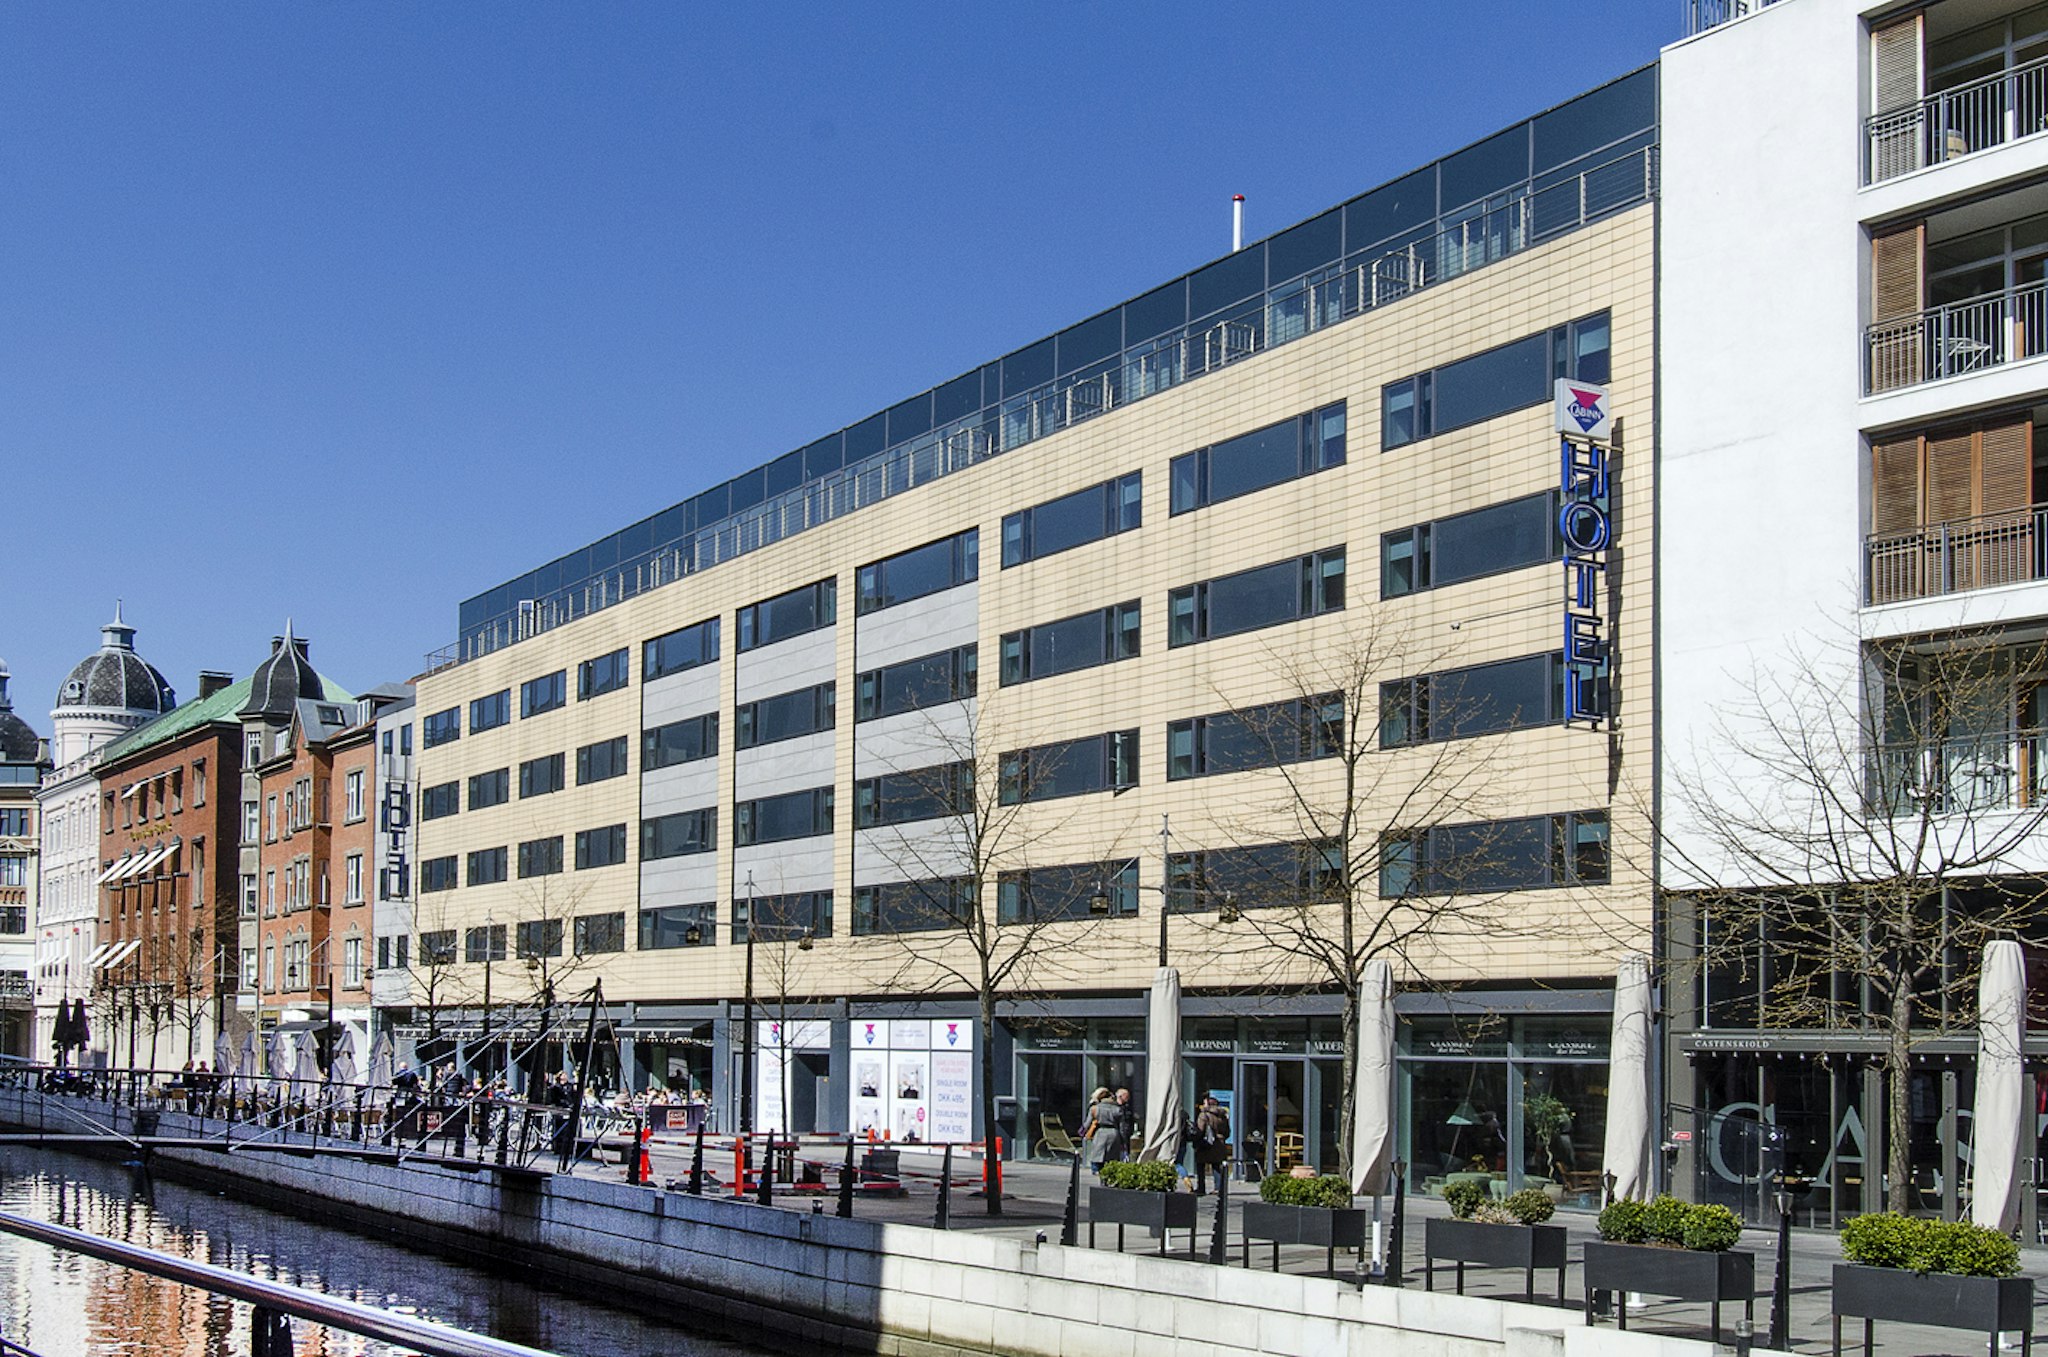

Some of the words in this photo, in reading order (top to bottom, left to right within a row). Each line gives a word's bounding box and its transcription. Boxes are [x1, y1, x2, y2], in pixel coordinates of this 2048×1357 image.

[1560, 438, 1611, 724] HOTEL
[1314, 1041, 1344, 1051] MODER
[1694, 1040, 1770, 1048] CASTENSKIOLD
